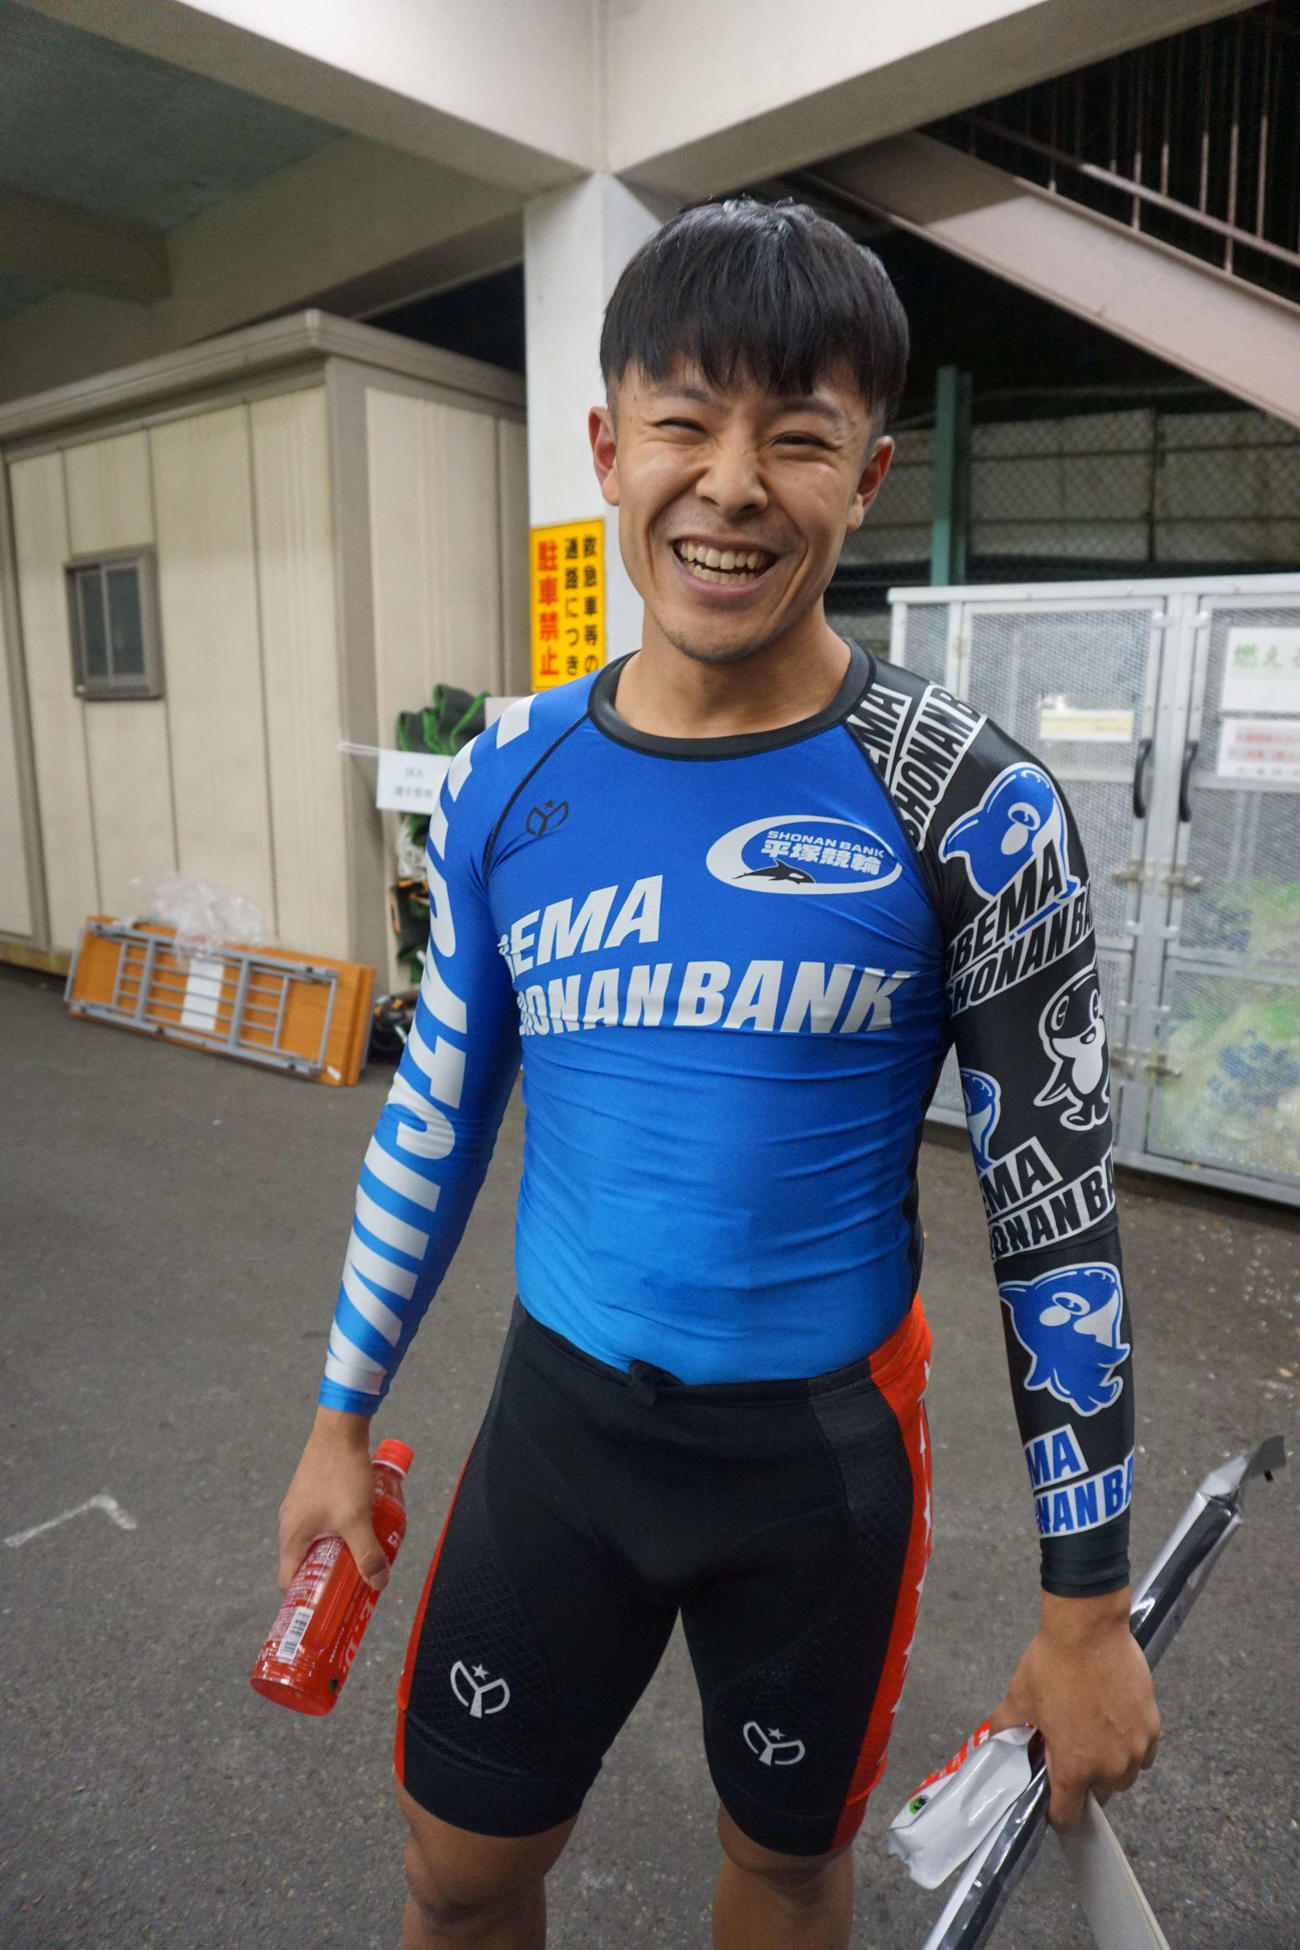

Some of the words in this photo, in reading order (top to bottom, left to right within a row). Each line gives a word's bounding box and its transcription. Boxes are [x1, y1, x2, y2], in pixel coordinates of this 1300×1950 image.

[537, 540, 559, 677] 駐車禁止
[564, 537, 580, 676] 通路につき
[583, 536, 599, 674] 救急車等の
[760, 839, 882, 876] 平塚競輪
[767, 830, 838, 848] SHONAN
[839, 841, 886, 858] BANK
[675, 960, 921, 1035] BANK
[981, 1145, 1055, 1216] MA
